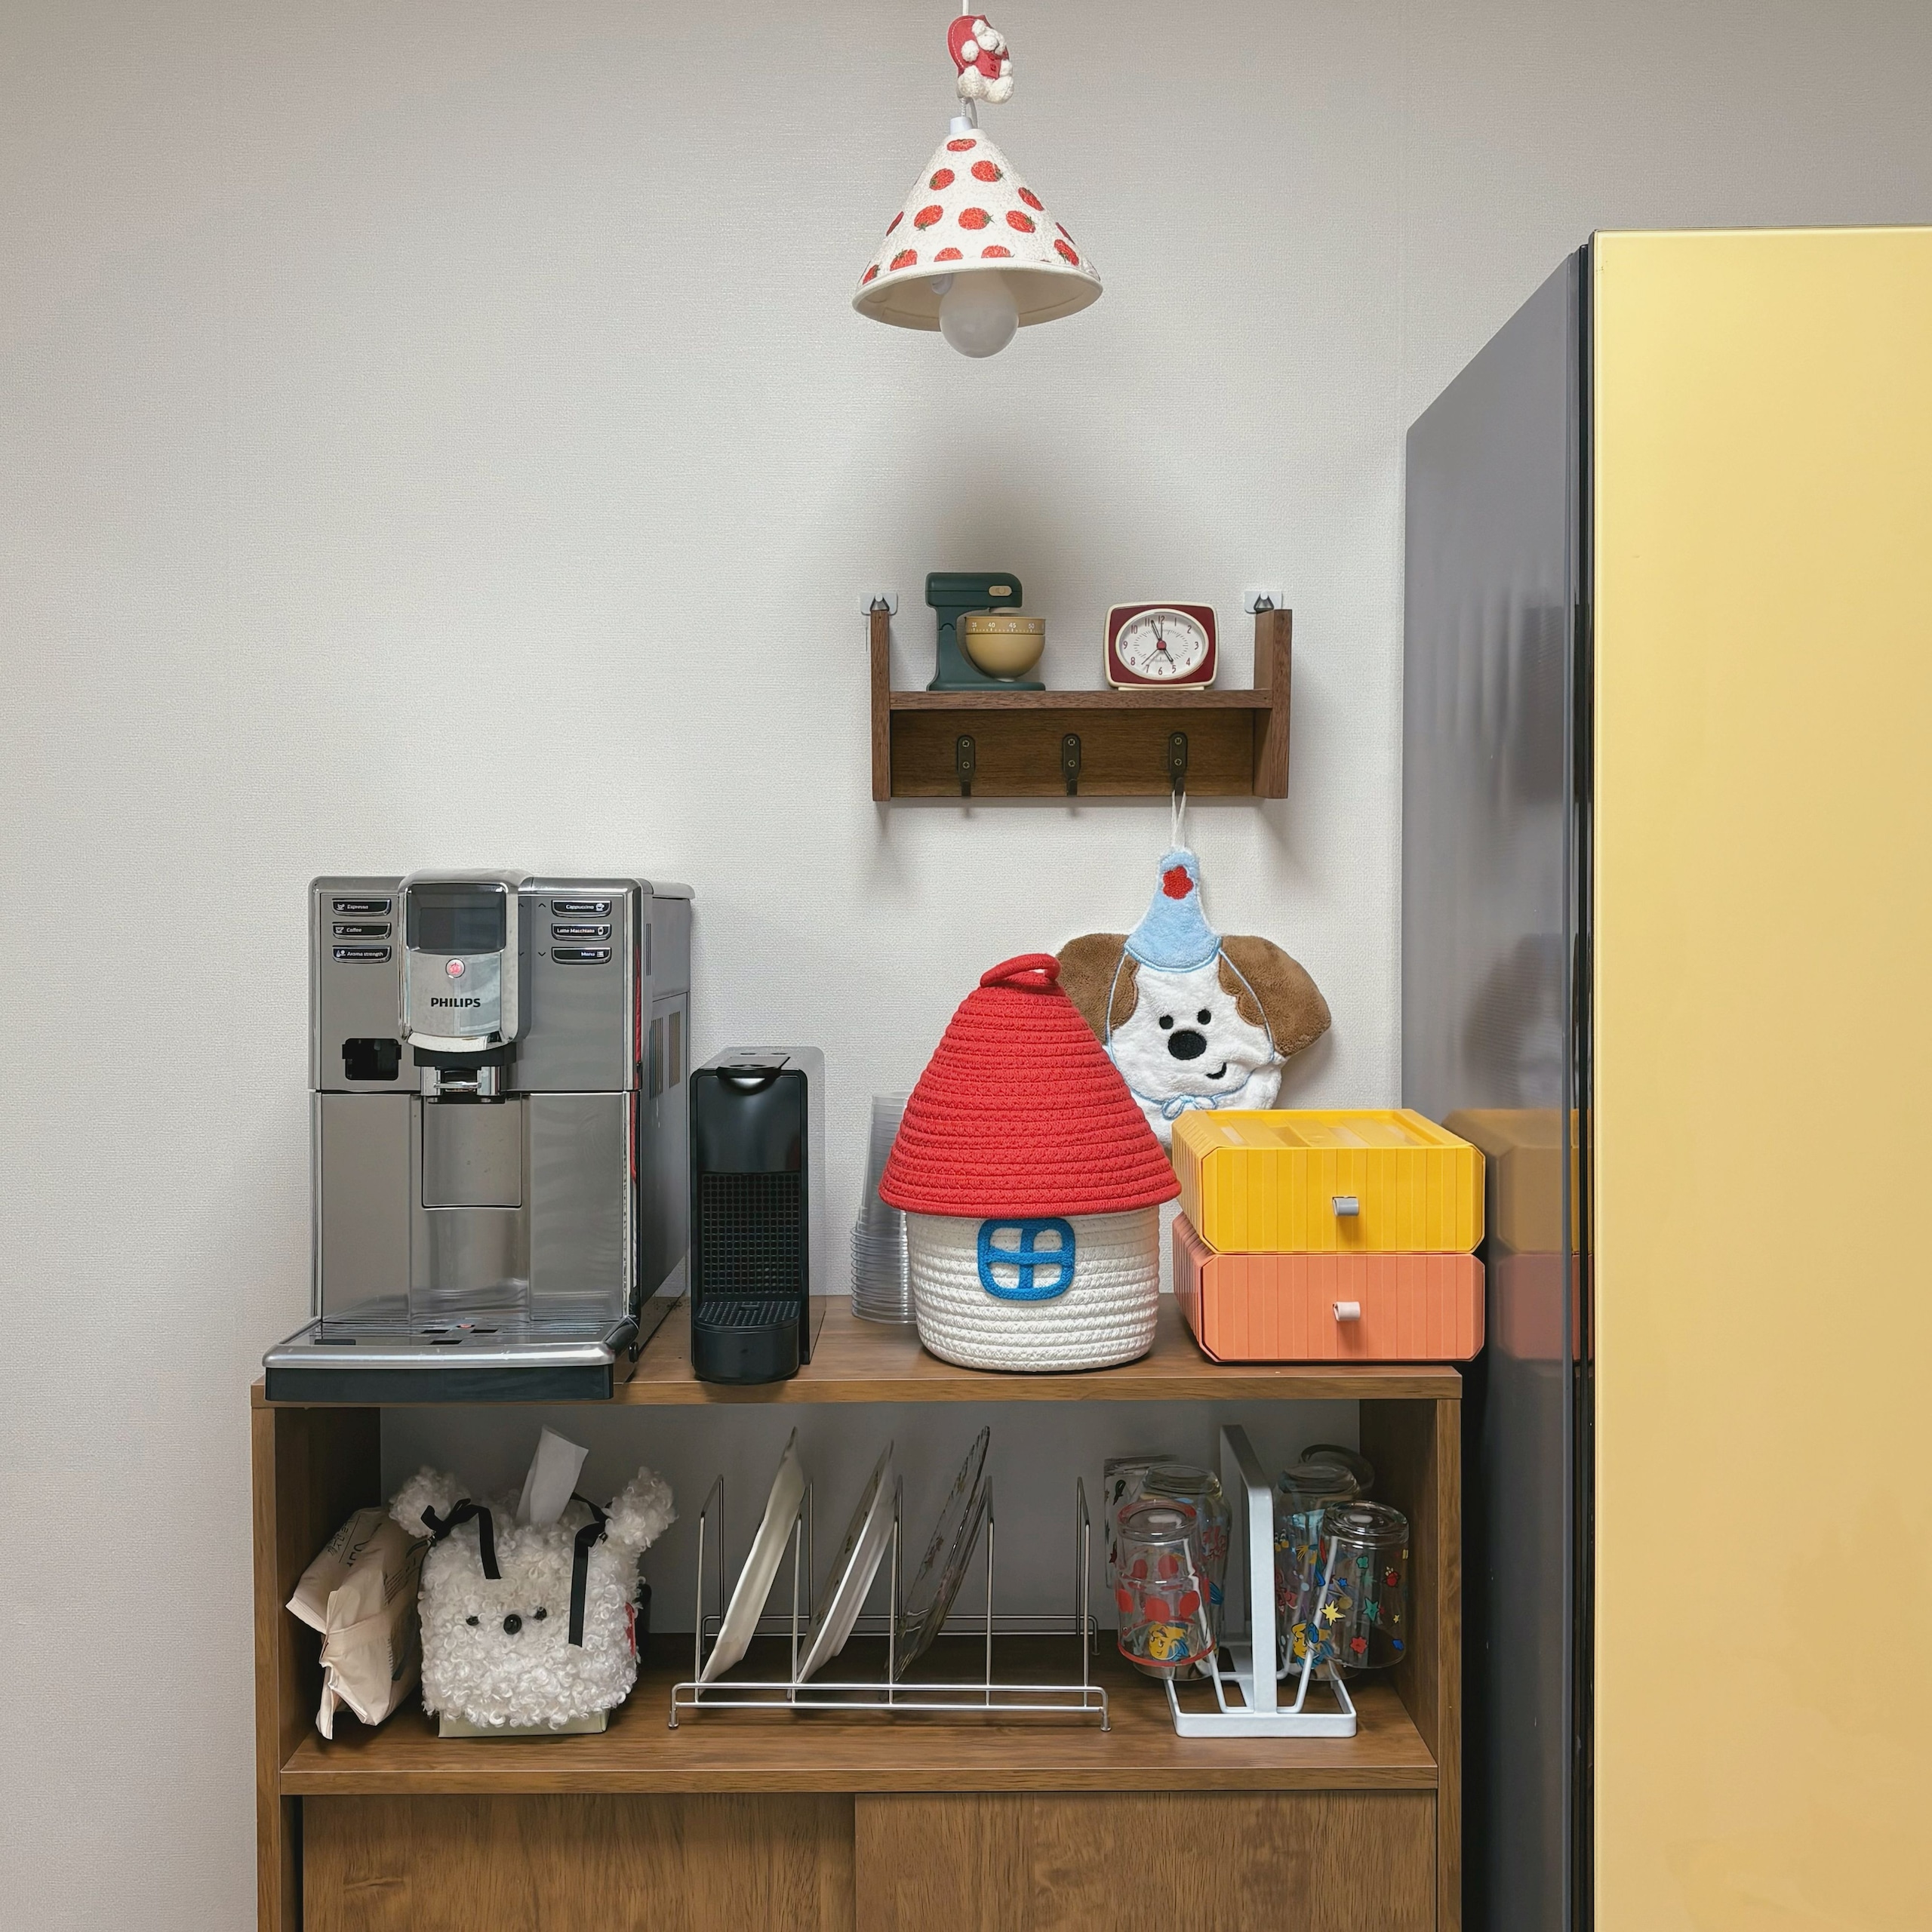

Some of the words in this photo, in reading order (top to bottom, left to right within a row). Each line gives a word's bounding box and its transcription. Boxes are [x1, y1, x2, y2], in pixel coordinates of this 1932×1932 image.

[1145, 618, 1150, 627] 11
[1158, 616, 1164, 624] 12
[1131, 625, 1138, 634] 10
[1186, 625, 1192, 634] 2
[1123, 641, 1128, 650] 9
[1194, 641, 1199, 650] 3
[1131, 657, 1136, 666] 8
[1186, 657, 1191, 666] 4
[1171, 665, 1177, 674] 5
[431, 998, 481, 1008] PHILIPS
